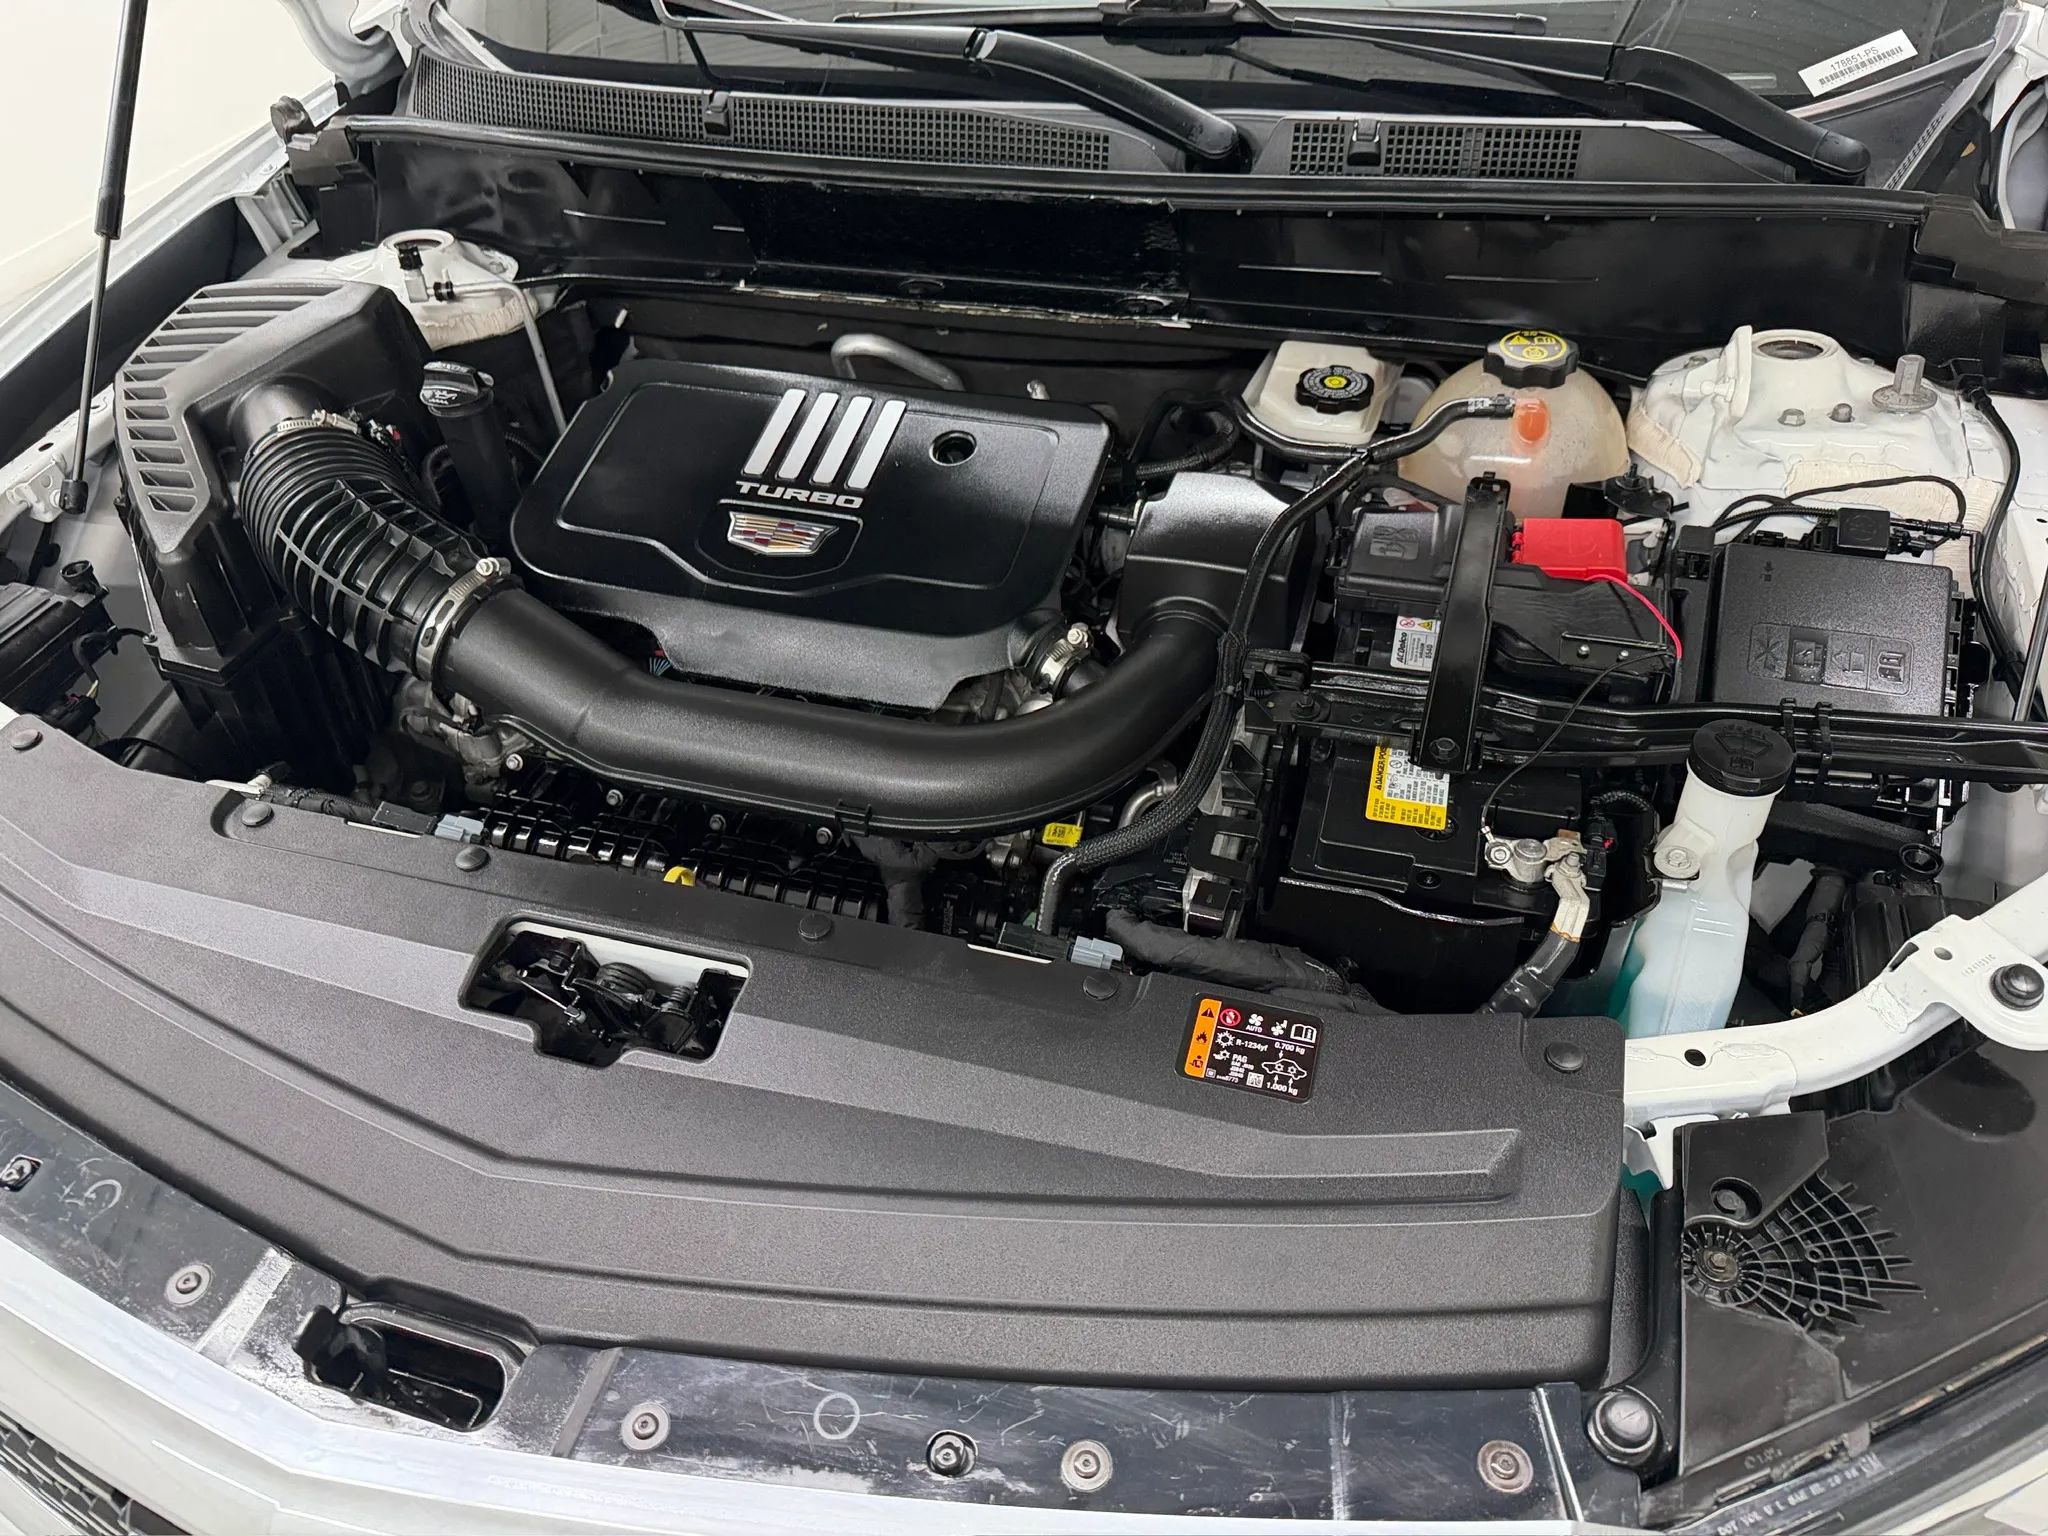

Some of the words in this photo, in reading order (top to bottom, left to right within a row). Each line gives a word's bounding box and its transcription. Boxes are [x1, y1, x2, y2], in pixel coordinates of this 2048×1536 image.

[1830, 46, 1880, 71] 178851-PS
[736, 481, 863, 508] TURBO
[1396, 632, 1408, 663] ACDelco
[1245, 1025, 1263, 1033] AUTO
[1235, 1038, 1268, 1052] R-1234yf
[1274, 1041, 1295, 1052] 0.700
[1295, 1045, 1306, 1055] kg
[1232, 1053, 1248, 1063] PAG
[1266, 1081, 1288, 1092] 1.000
[1288, 1084, 1298, 1096] kg
